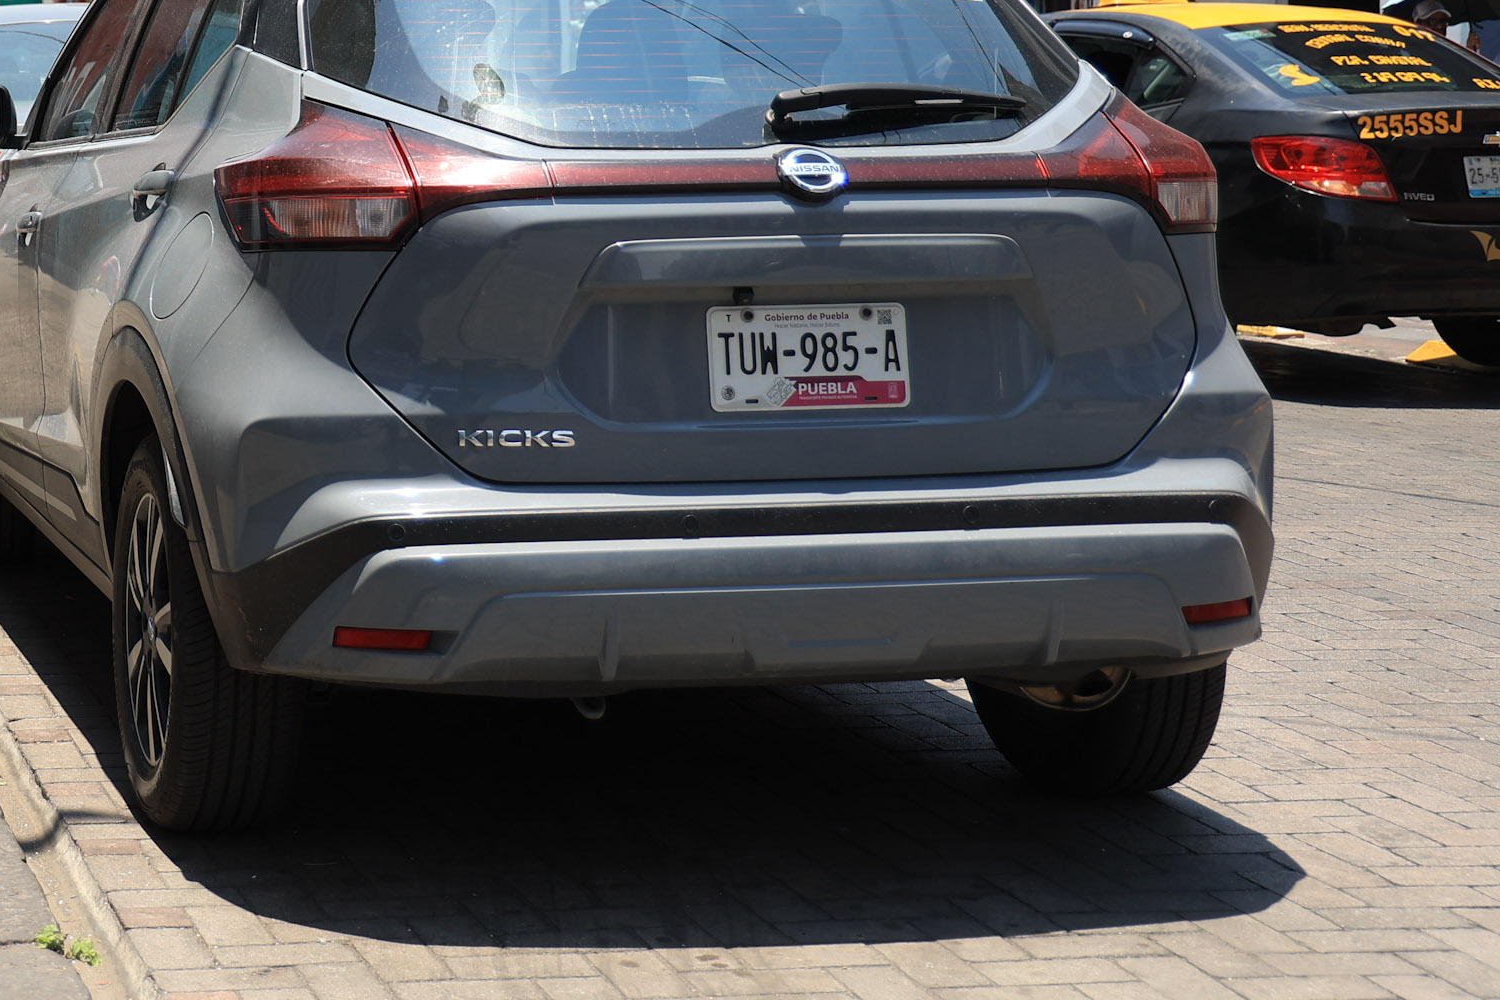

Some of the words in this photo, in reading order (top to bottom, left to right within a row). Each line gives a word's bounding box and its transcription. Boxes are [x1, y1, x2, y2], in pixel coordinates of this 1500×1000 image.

[1357, 110, 1463, 139] 2555SSJ
[1469, 167, 1500, 184] 25-5
[1404, 192, 1435, 201] AVEO
[726, 314, 731, 322] T
[764, 313, 805, 322] Gobierno
[807, 313, 818, 321] de
[819, 312, 849, 321] Puebla
[717, 329, 901, 376] TUW-985-A
[798, 381, 857, 395] PUEBLA
[457, 429, 576, 447] KICKS
